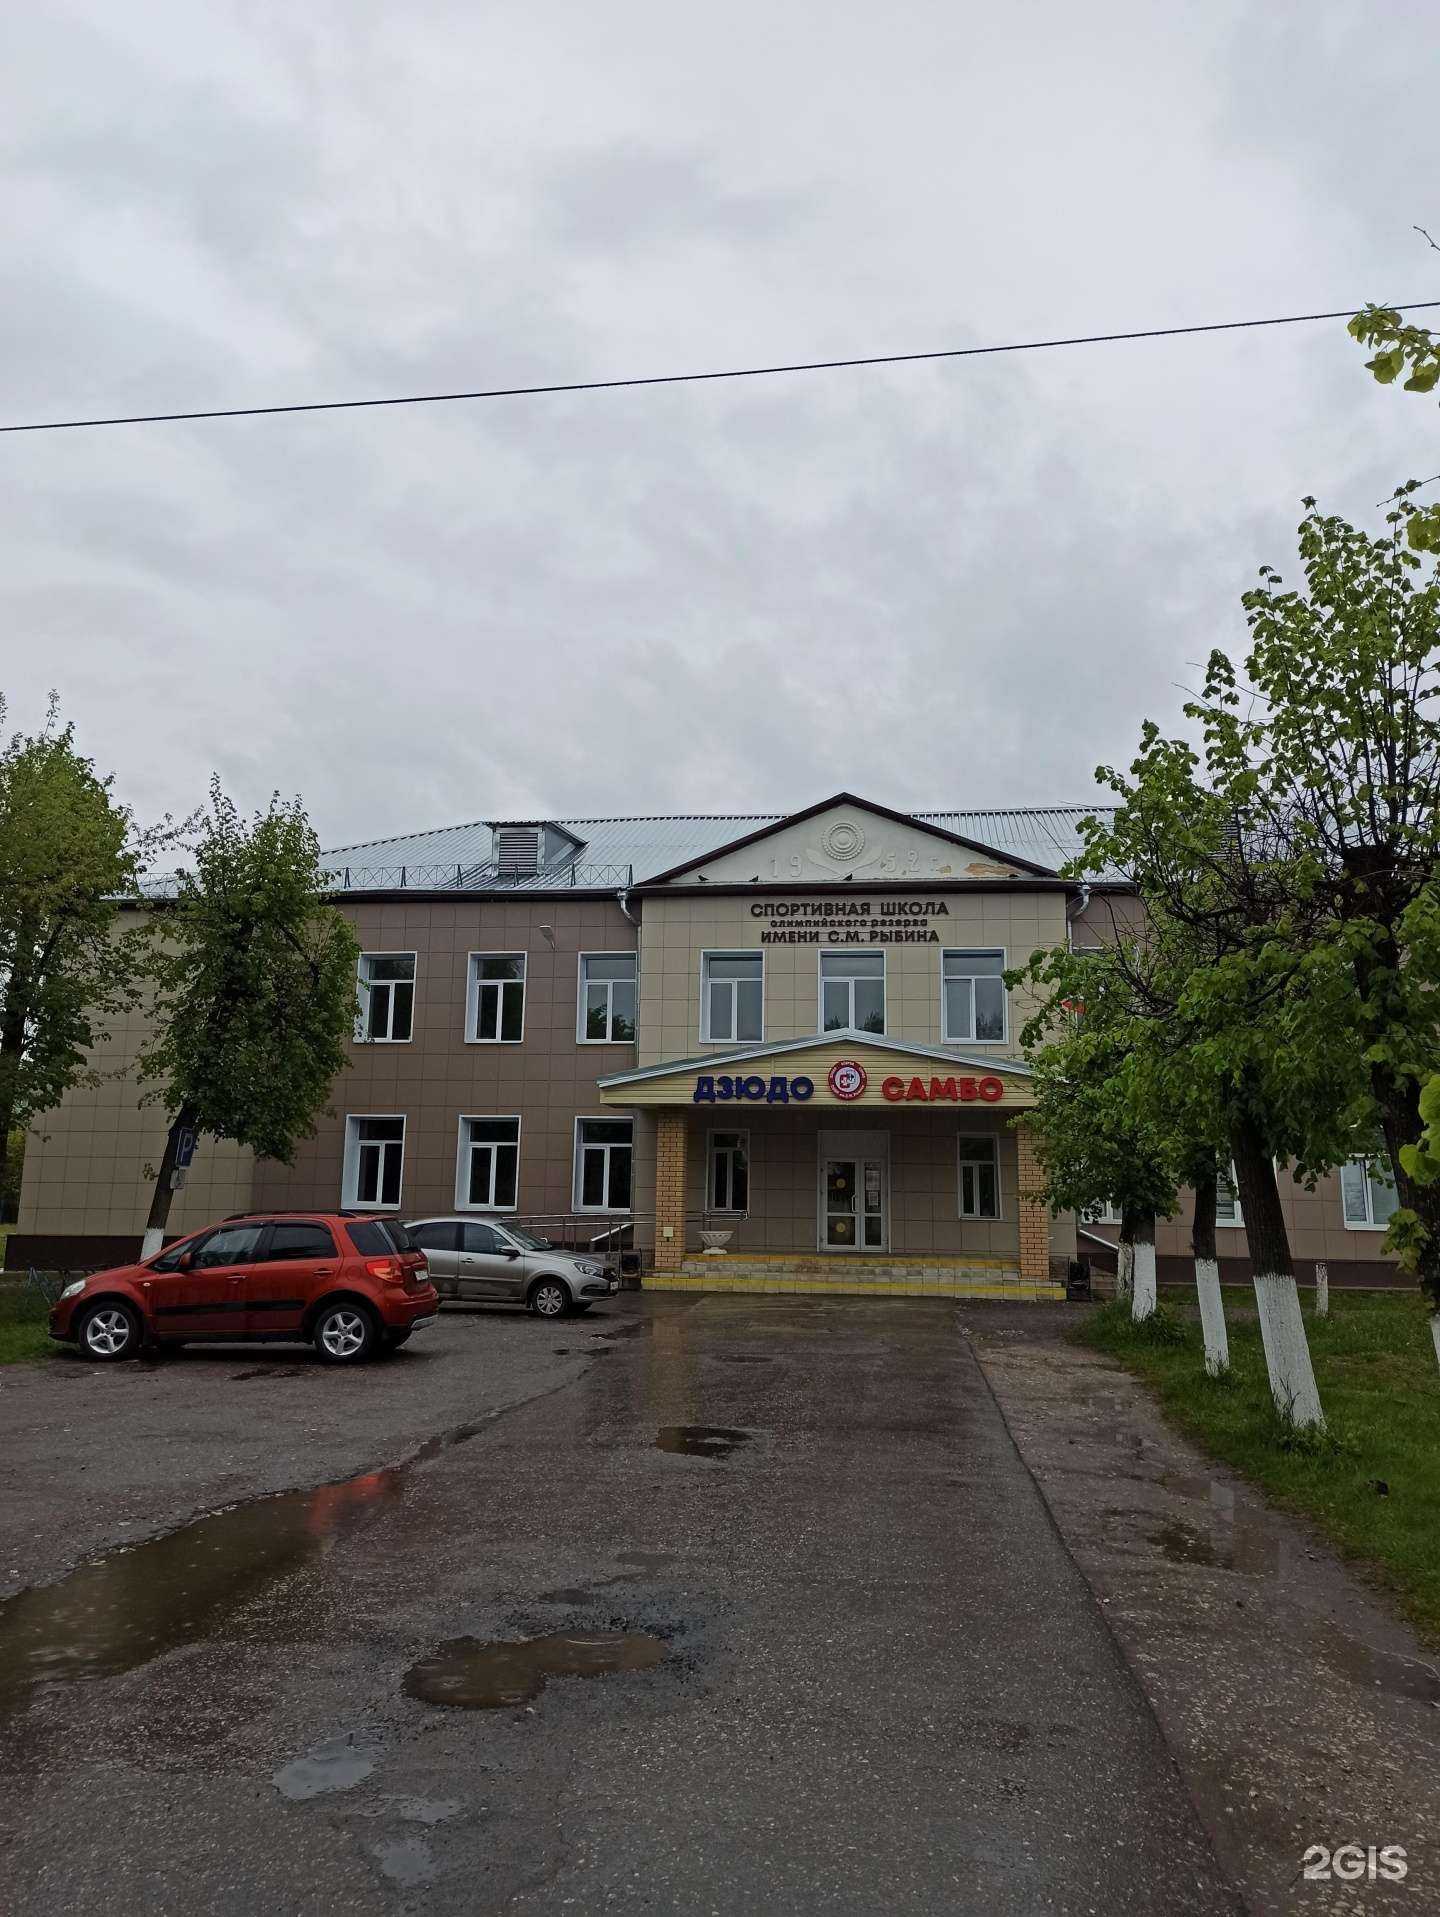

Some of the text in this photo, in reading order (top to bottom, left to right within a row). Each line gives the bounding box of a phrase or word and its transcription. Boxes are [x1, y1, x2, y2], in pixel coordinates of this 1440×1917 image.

[769, 854, 803, 878] 19
[750, 901, 950, 918] СПОРТИВНАЯ ШКОЛА
[761, 930, 940, 944] ИМЕНИ С.М. РЫБИНА
[693, 1076, 814, 1103] ДЗЮДО
[881, 1076, 1004, 1102] САМБО
[181, 1133, 194, 1163] P
